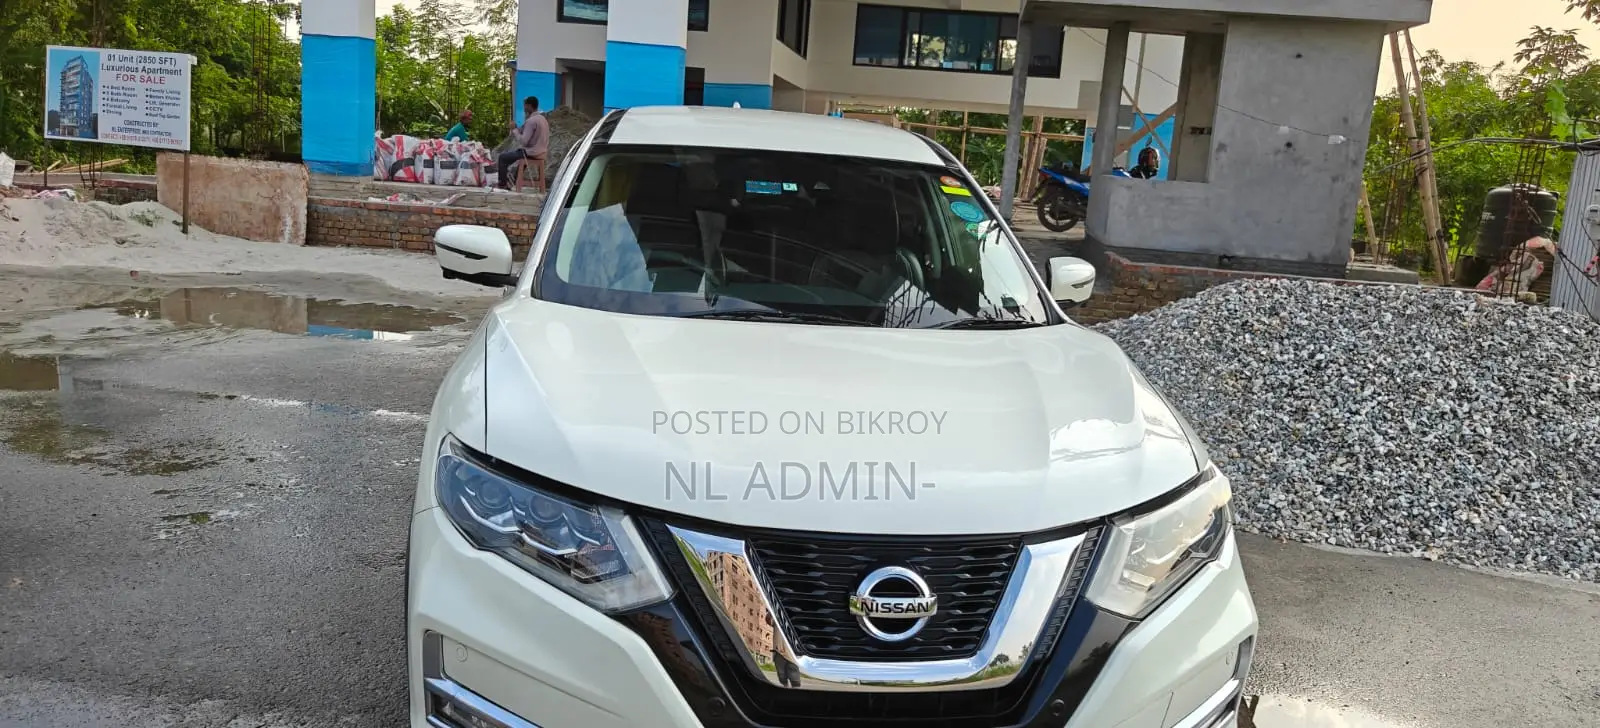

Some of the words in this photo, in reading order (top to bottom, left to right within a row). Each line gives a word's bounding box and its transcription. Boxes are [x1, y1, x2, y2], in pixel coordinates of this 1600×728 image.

[107, 54, 115, 62] 01
[118, 54, 134, 63] Unit
[136, 55, 156, 65] (2850
[158, 57, 177, 67] SFT)
[101, 63, 139, 73] Luxurious
[141, 66, 182, 76] Apartment
[116, 73, 136, 82] FOR
[139, 75, 166, 85] SALE
[860, 601, 929, 614] NISSAN
